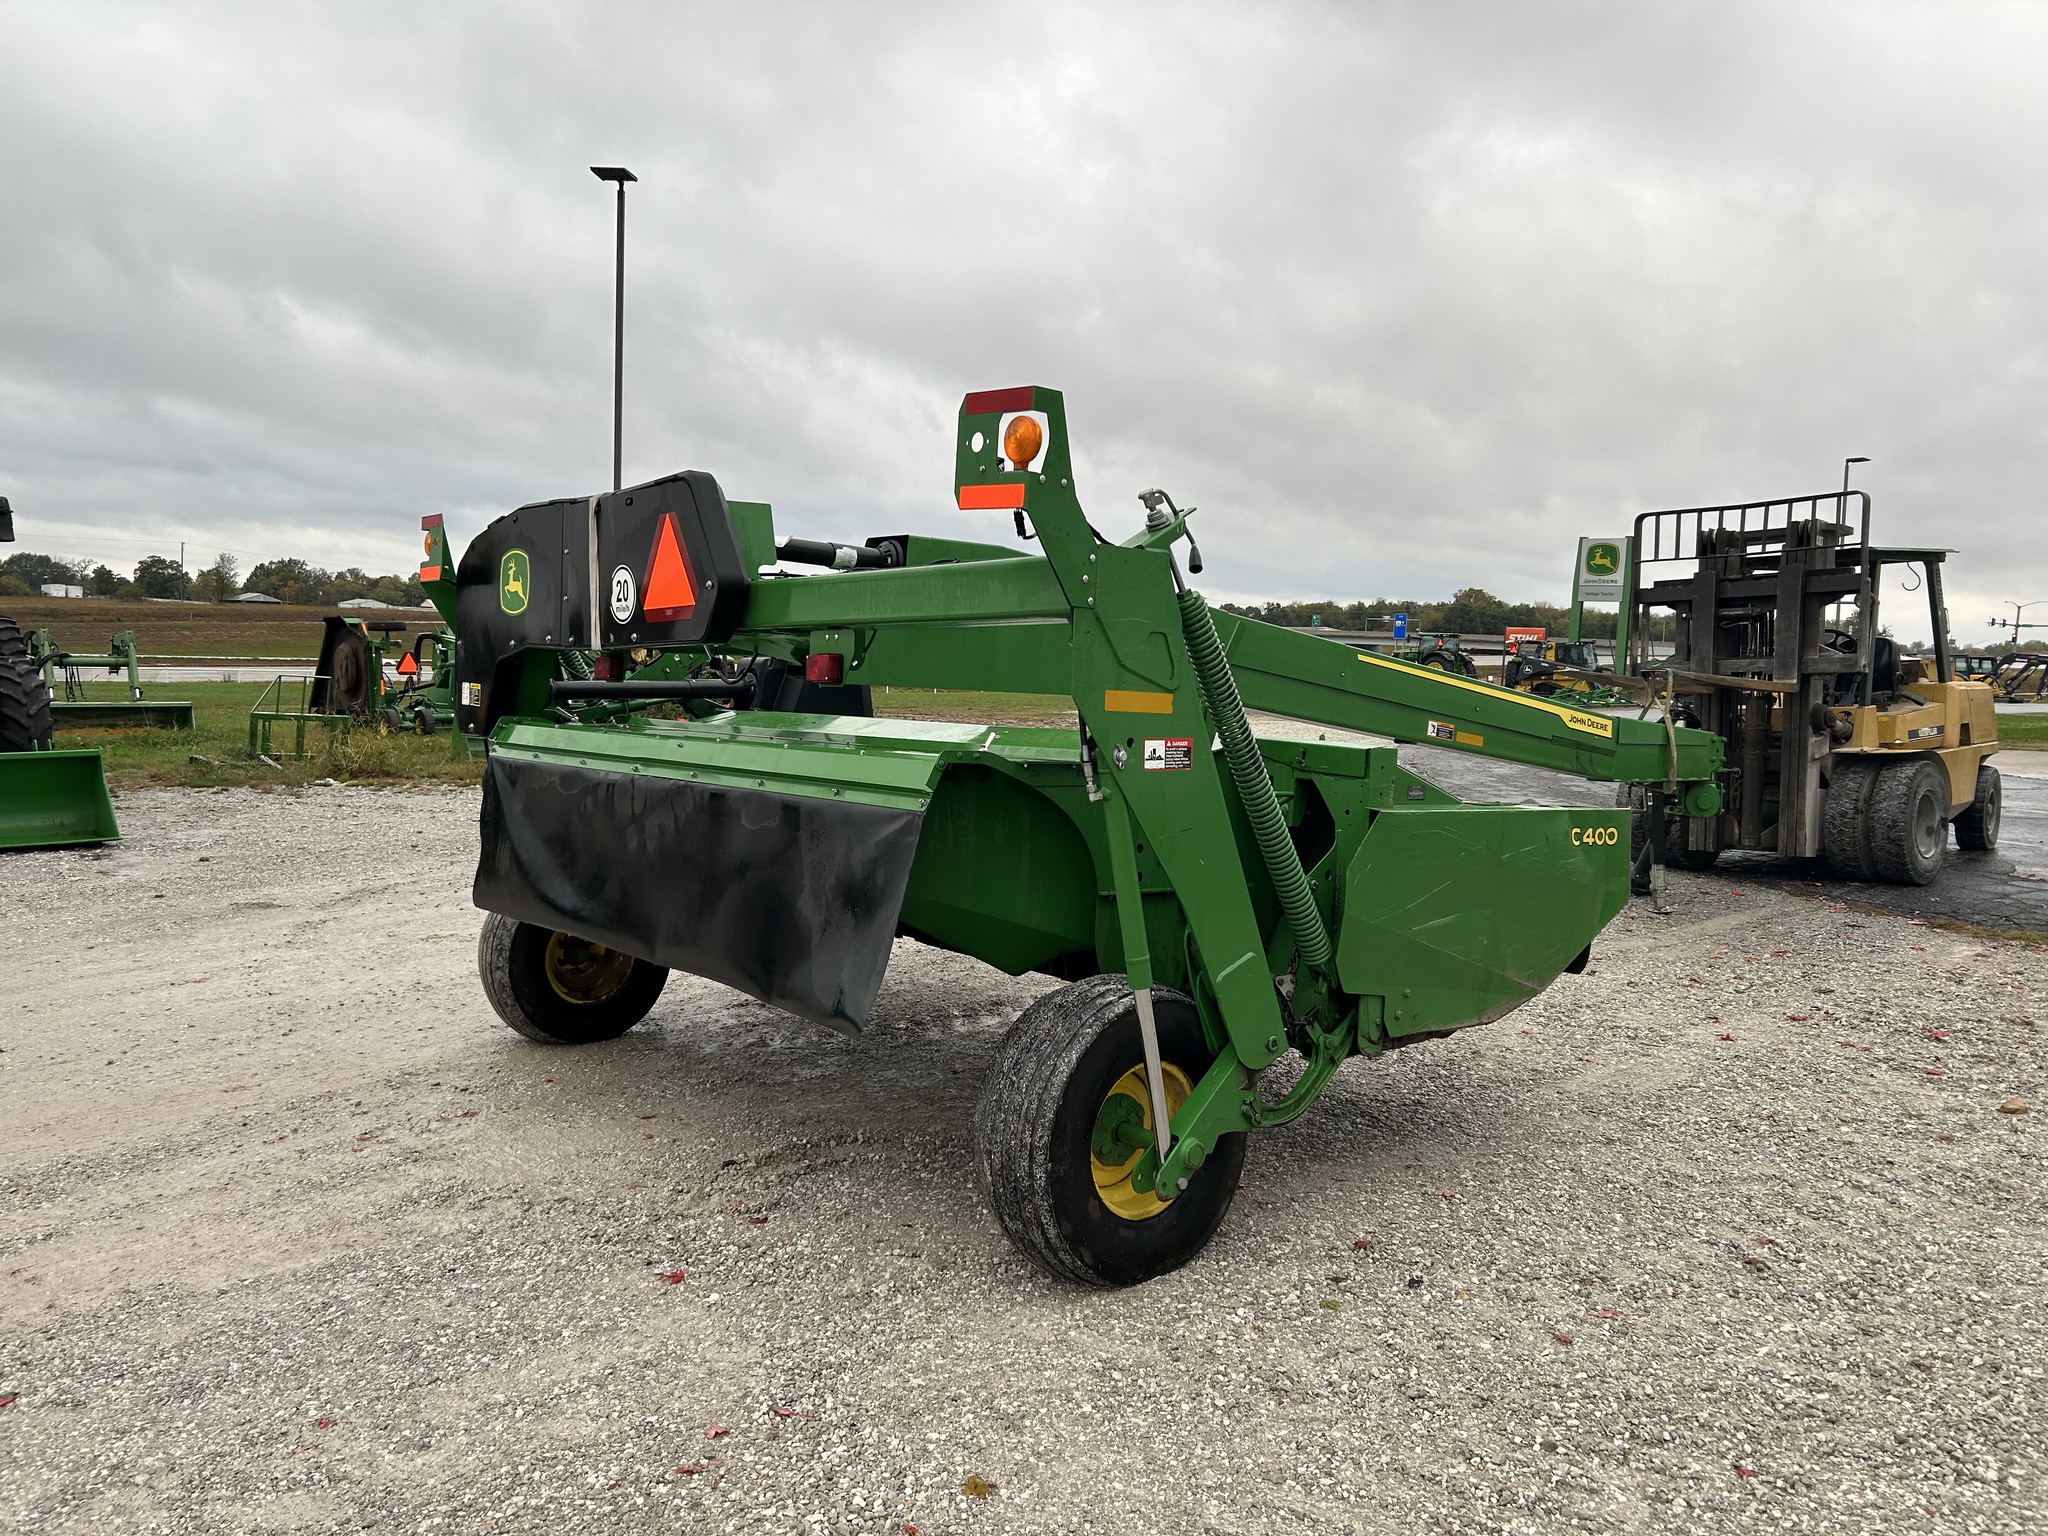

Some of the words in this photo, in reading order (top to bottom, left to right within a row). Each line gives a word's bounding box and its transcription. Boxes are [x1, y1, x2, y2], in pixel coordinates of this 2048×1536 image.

[616, 579, 628, 602] 20
[1506, 634, 1538, 643] STIHL
[1569, 714, 1586, 726] JOHN
[1587, 718, 1608, 731] DEERE
